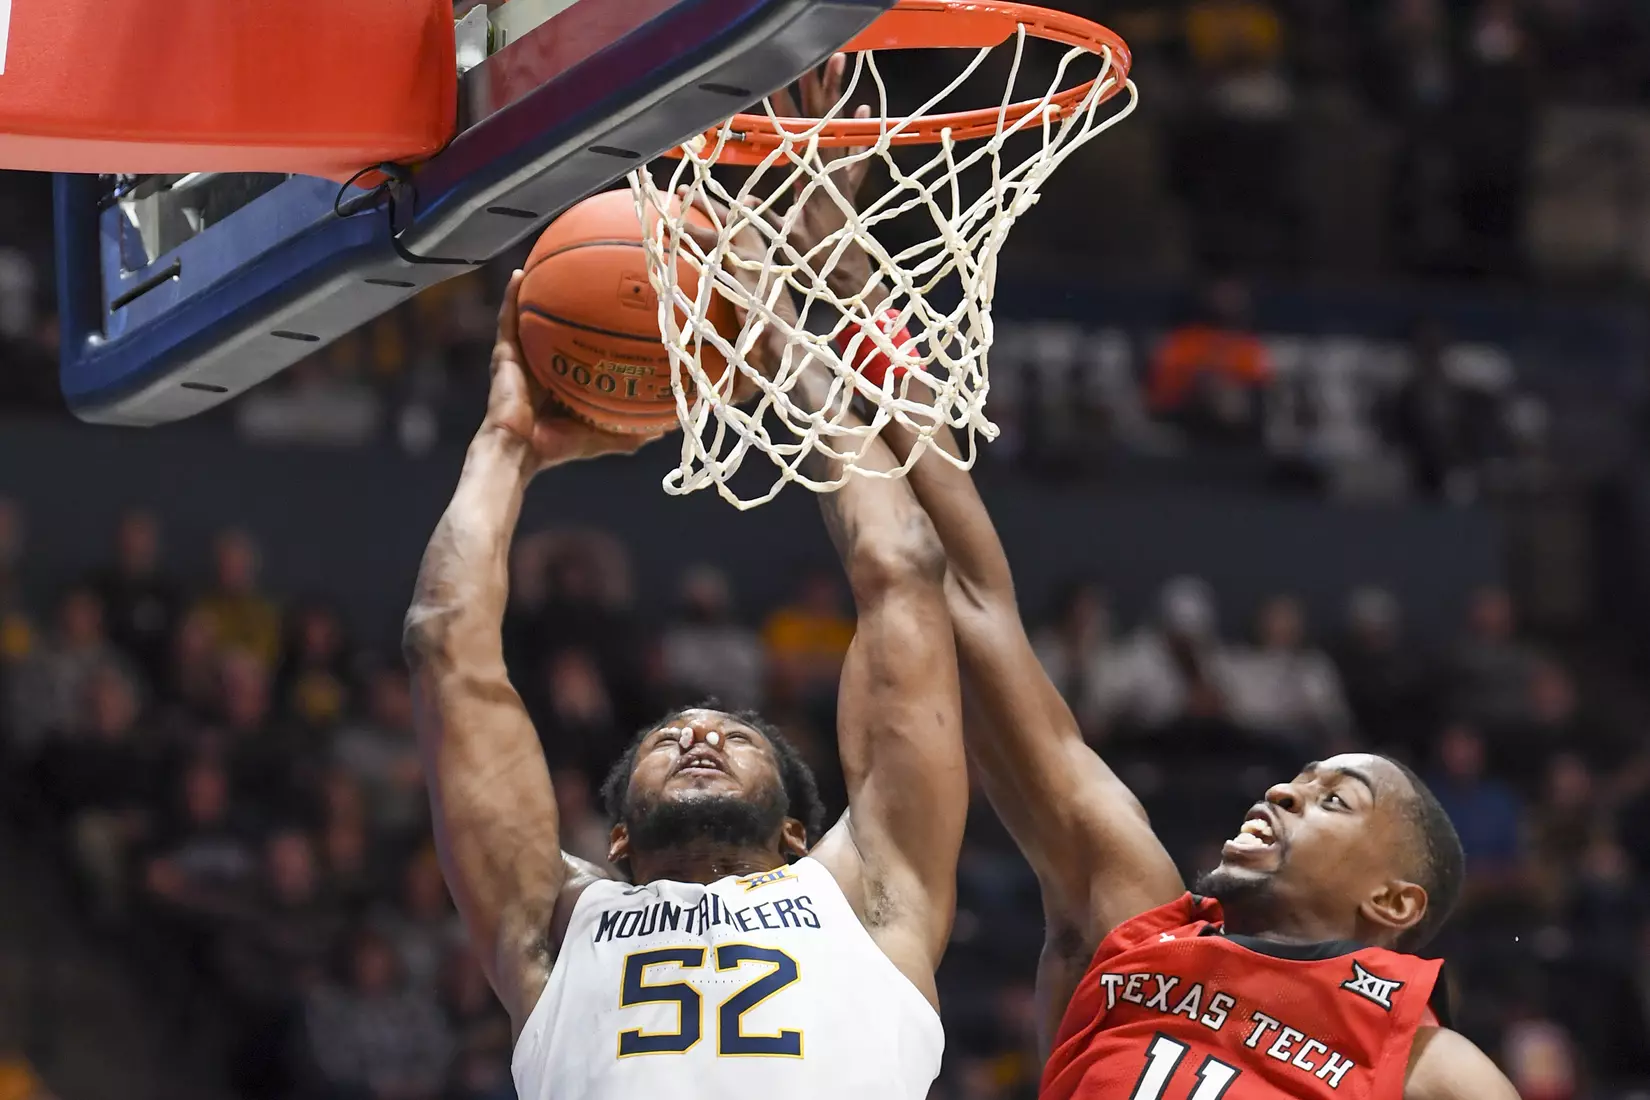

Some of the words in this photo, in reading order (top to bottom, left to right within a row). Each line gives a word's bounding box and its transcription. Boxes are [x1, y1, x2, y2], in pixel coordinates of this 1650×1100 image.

[617, 943, 804, 1059] 52
[1100, 973, 1234, 1030] TEXAS
[1244, 1011, 1355, 1088] TECH
[1341, 960, 1404, 1010] XII
[1128, 1030, 1243, 1100] 11
